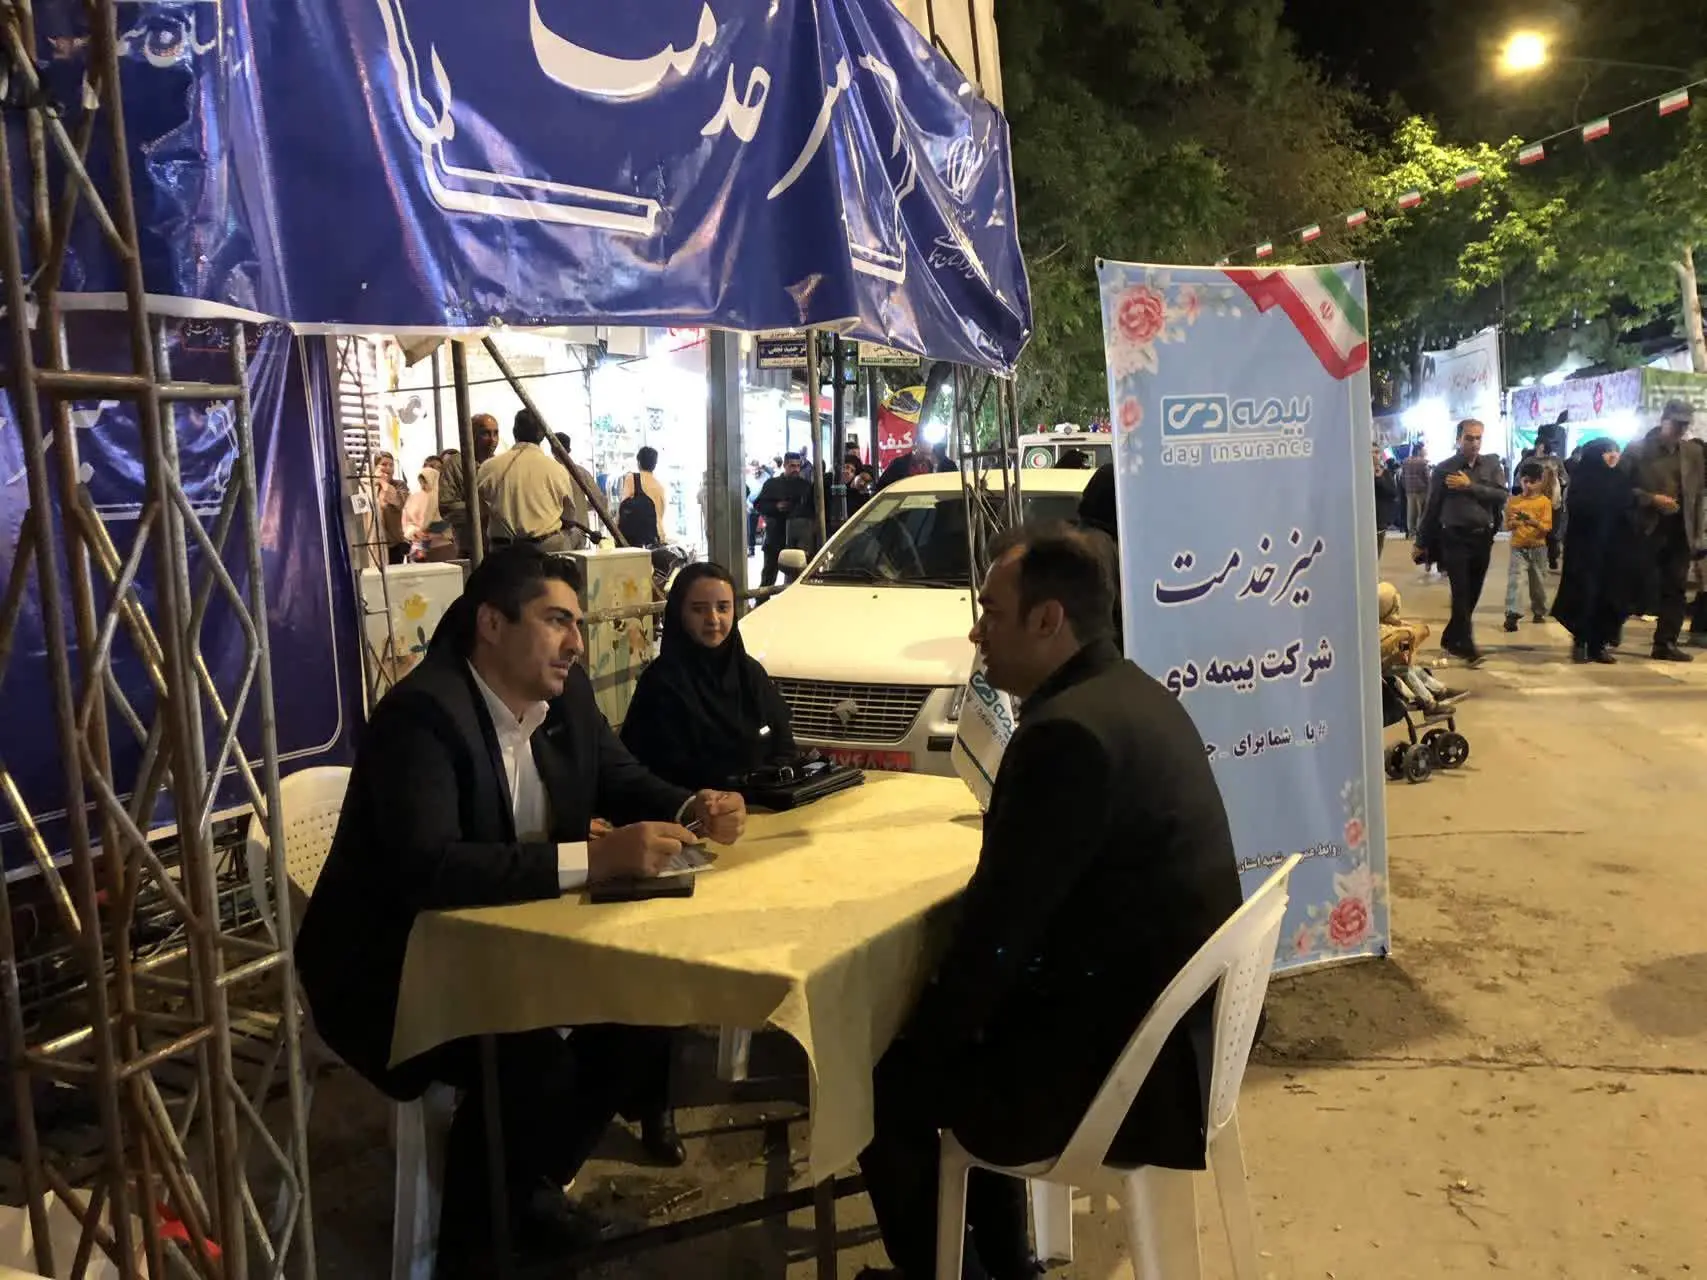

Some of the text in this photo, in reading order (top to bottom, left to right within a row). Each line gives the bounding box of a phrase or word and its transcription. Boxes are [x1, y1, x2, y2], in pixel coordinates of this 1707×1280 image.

[1231, 396, 1312, 436] بیمه
[879, 431, 914, 453] کیف
[1163, 438, 1312, 466] day insurance
[1155, 529, 1324, 606] میز خدمت
[1166, 639, 1333, 698] شرکت بیمه دی
[1233, 733, 1265, 757] برای
[1267, 727, 1292, 746] شما
